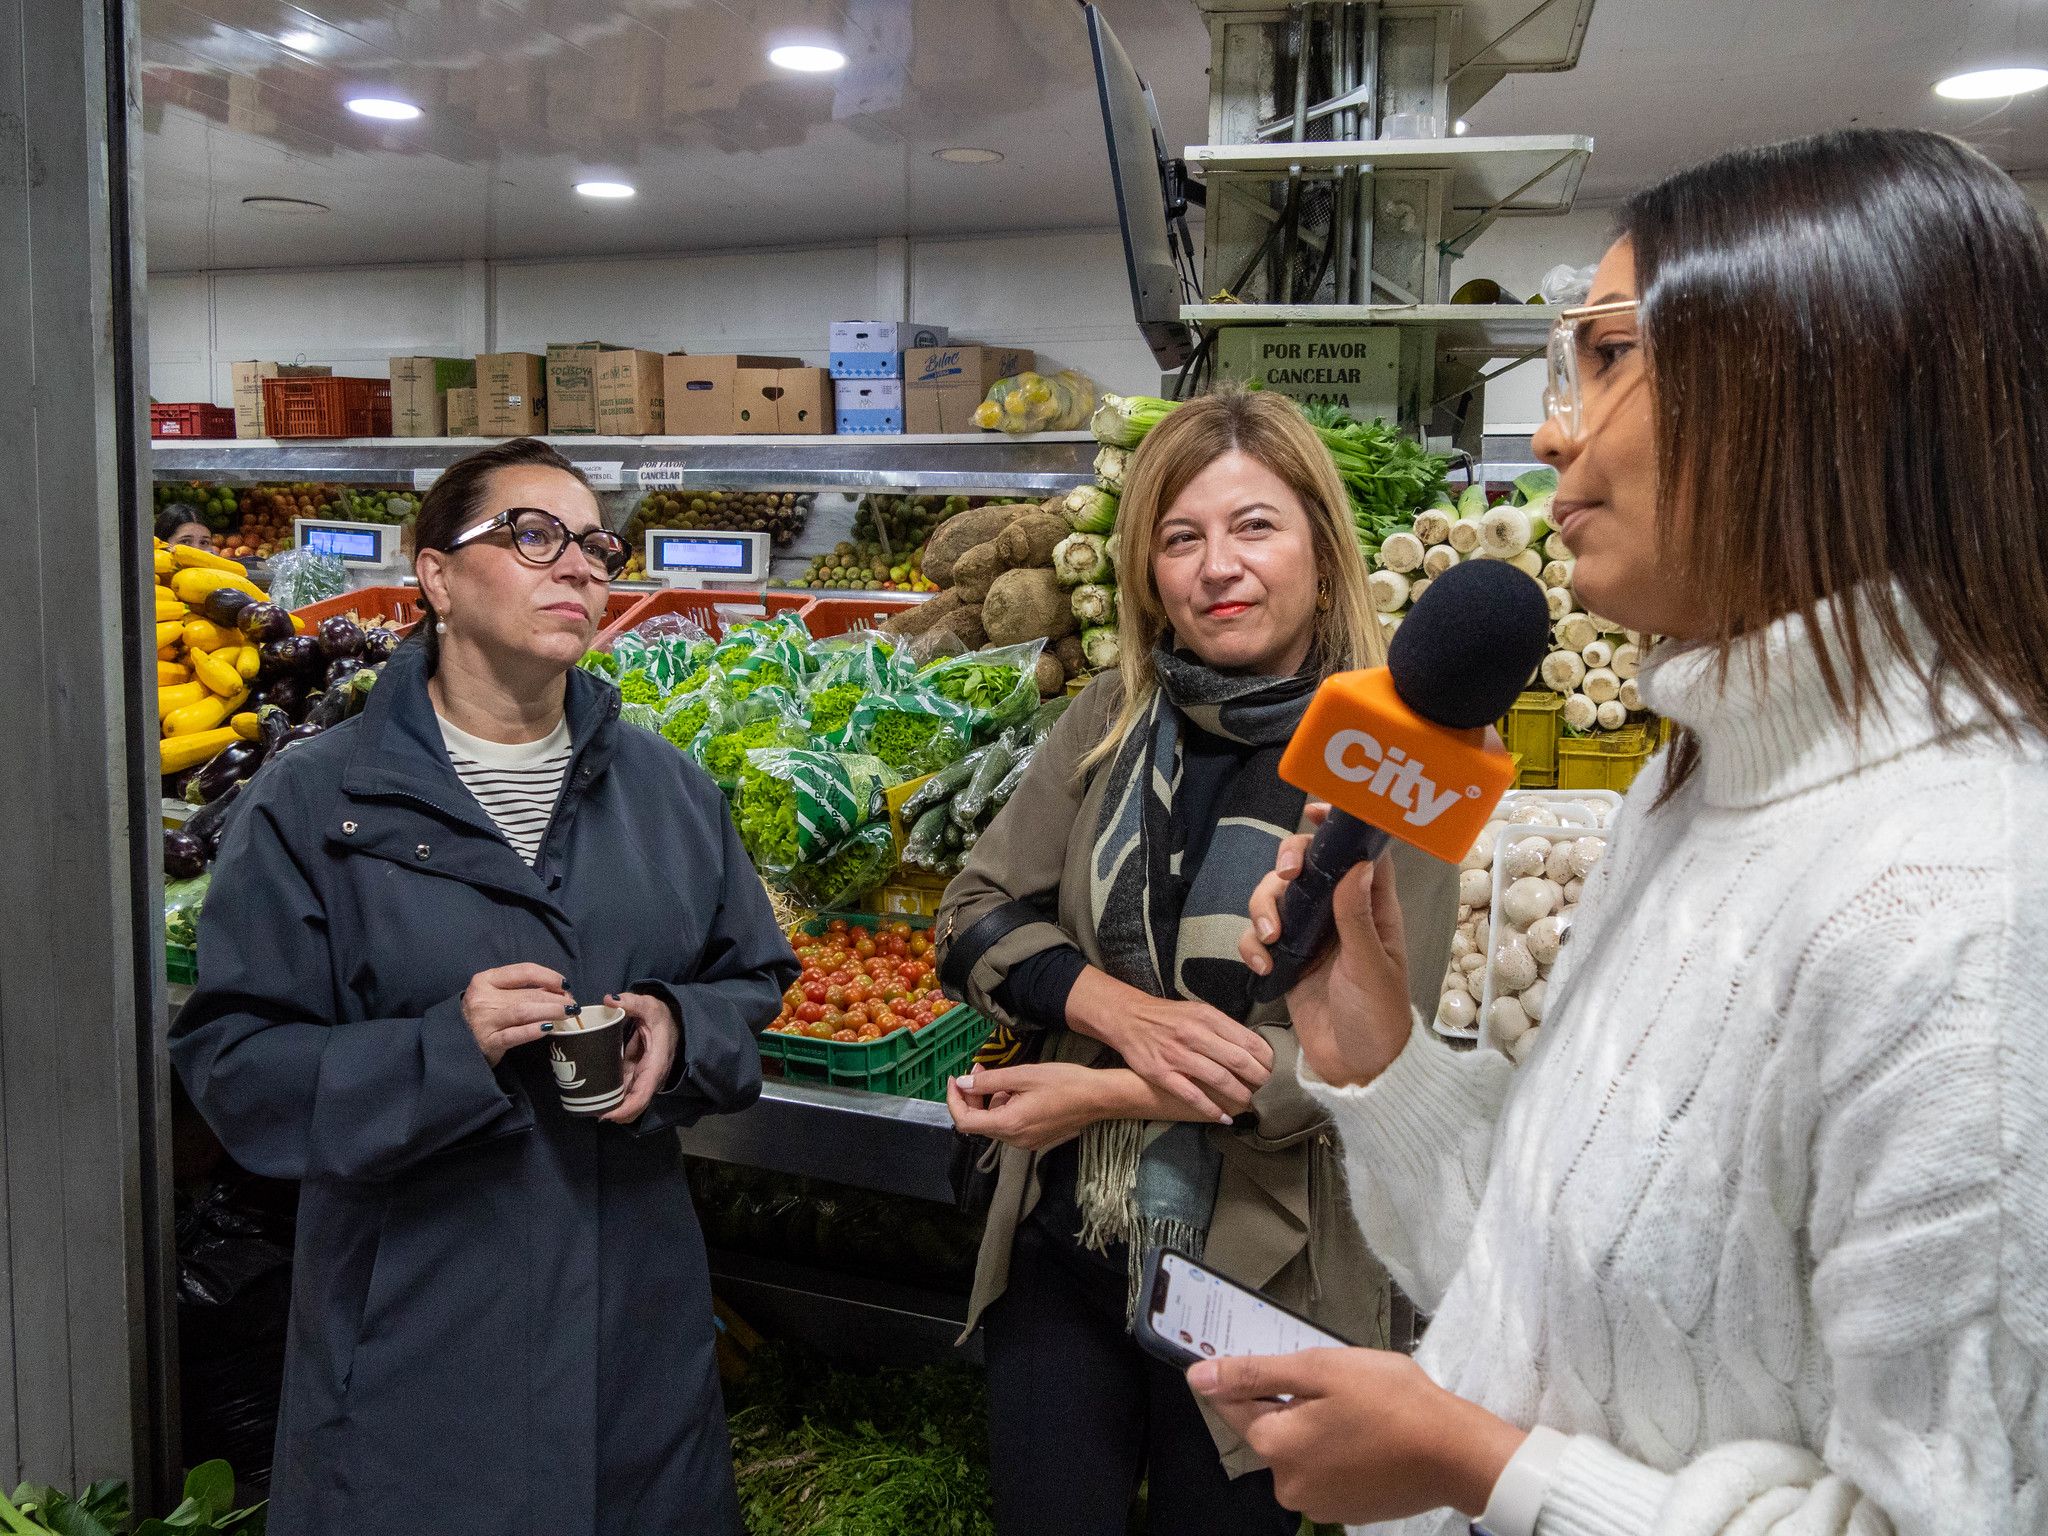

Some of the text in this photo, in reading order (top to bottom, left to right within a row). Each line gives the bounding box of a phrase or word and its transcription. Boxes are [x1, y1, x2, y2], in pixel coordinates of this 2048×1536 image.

[1263, 342, 1367, 359] POR FAVOR
[1266, 368, 1361, 384] CANCELAR
[640, 471, 680, 480] CANCELAR
[1324, 729, 1462, 827] City
